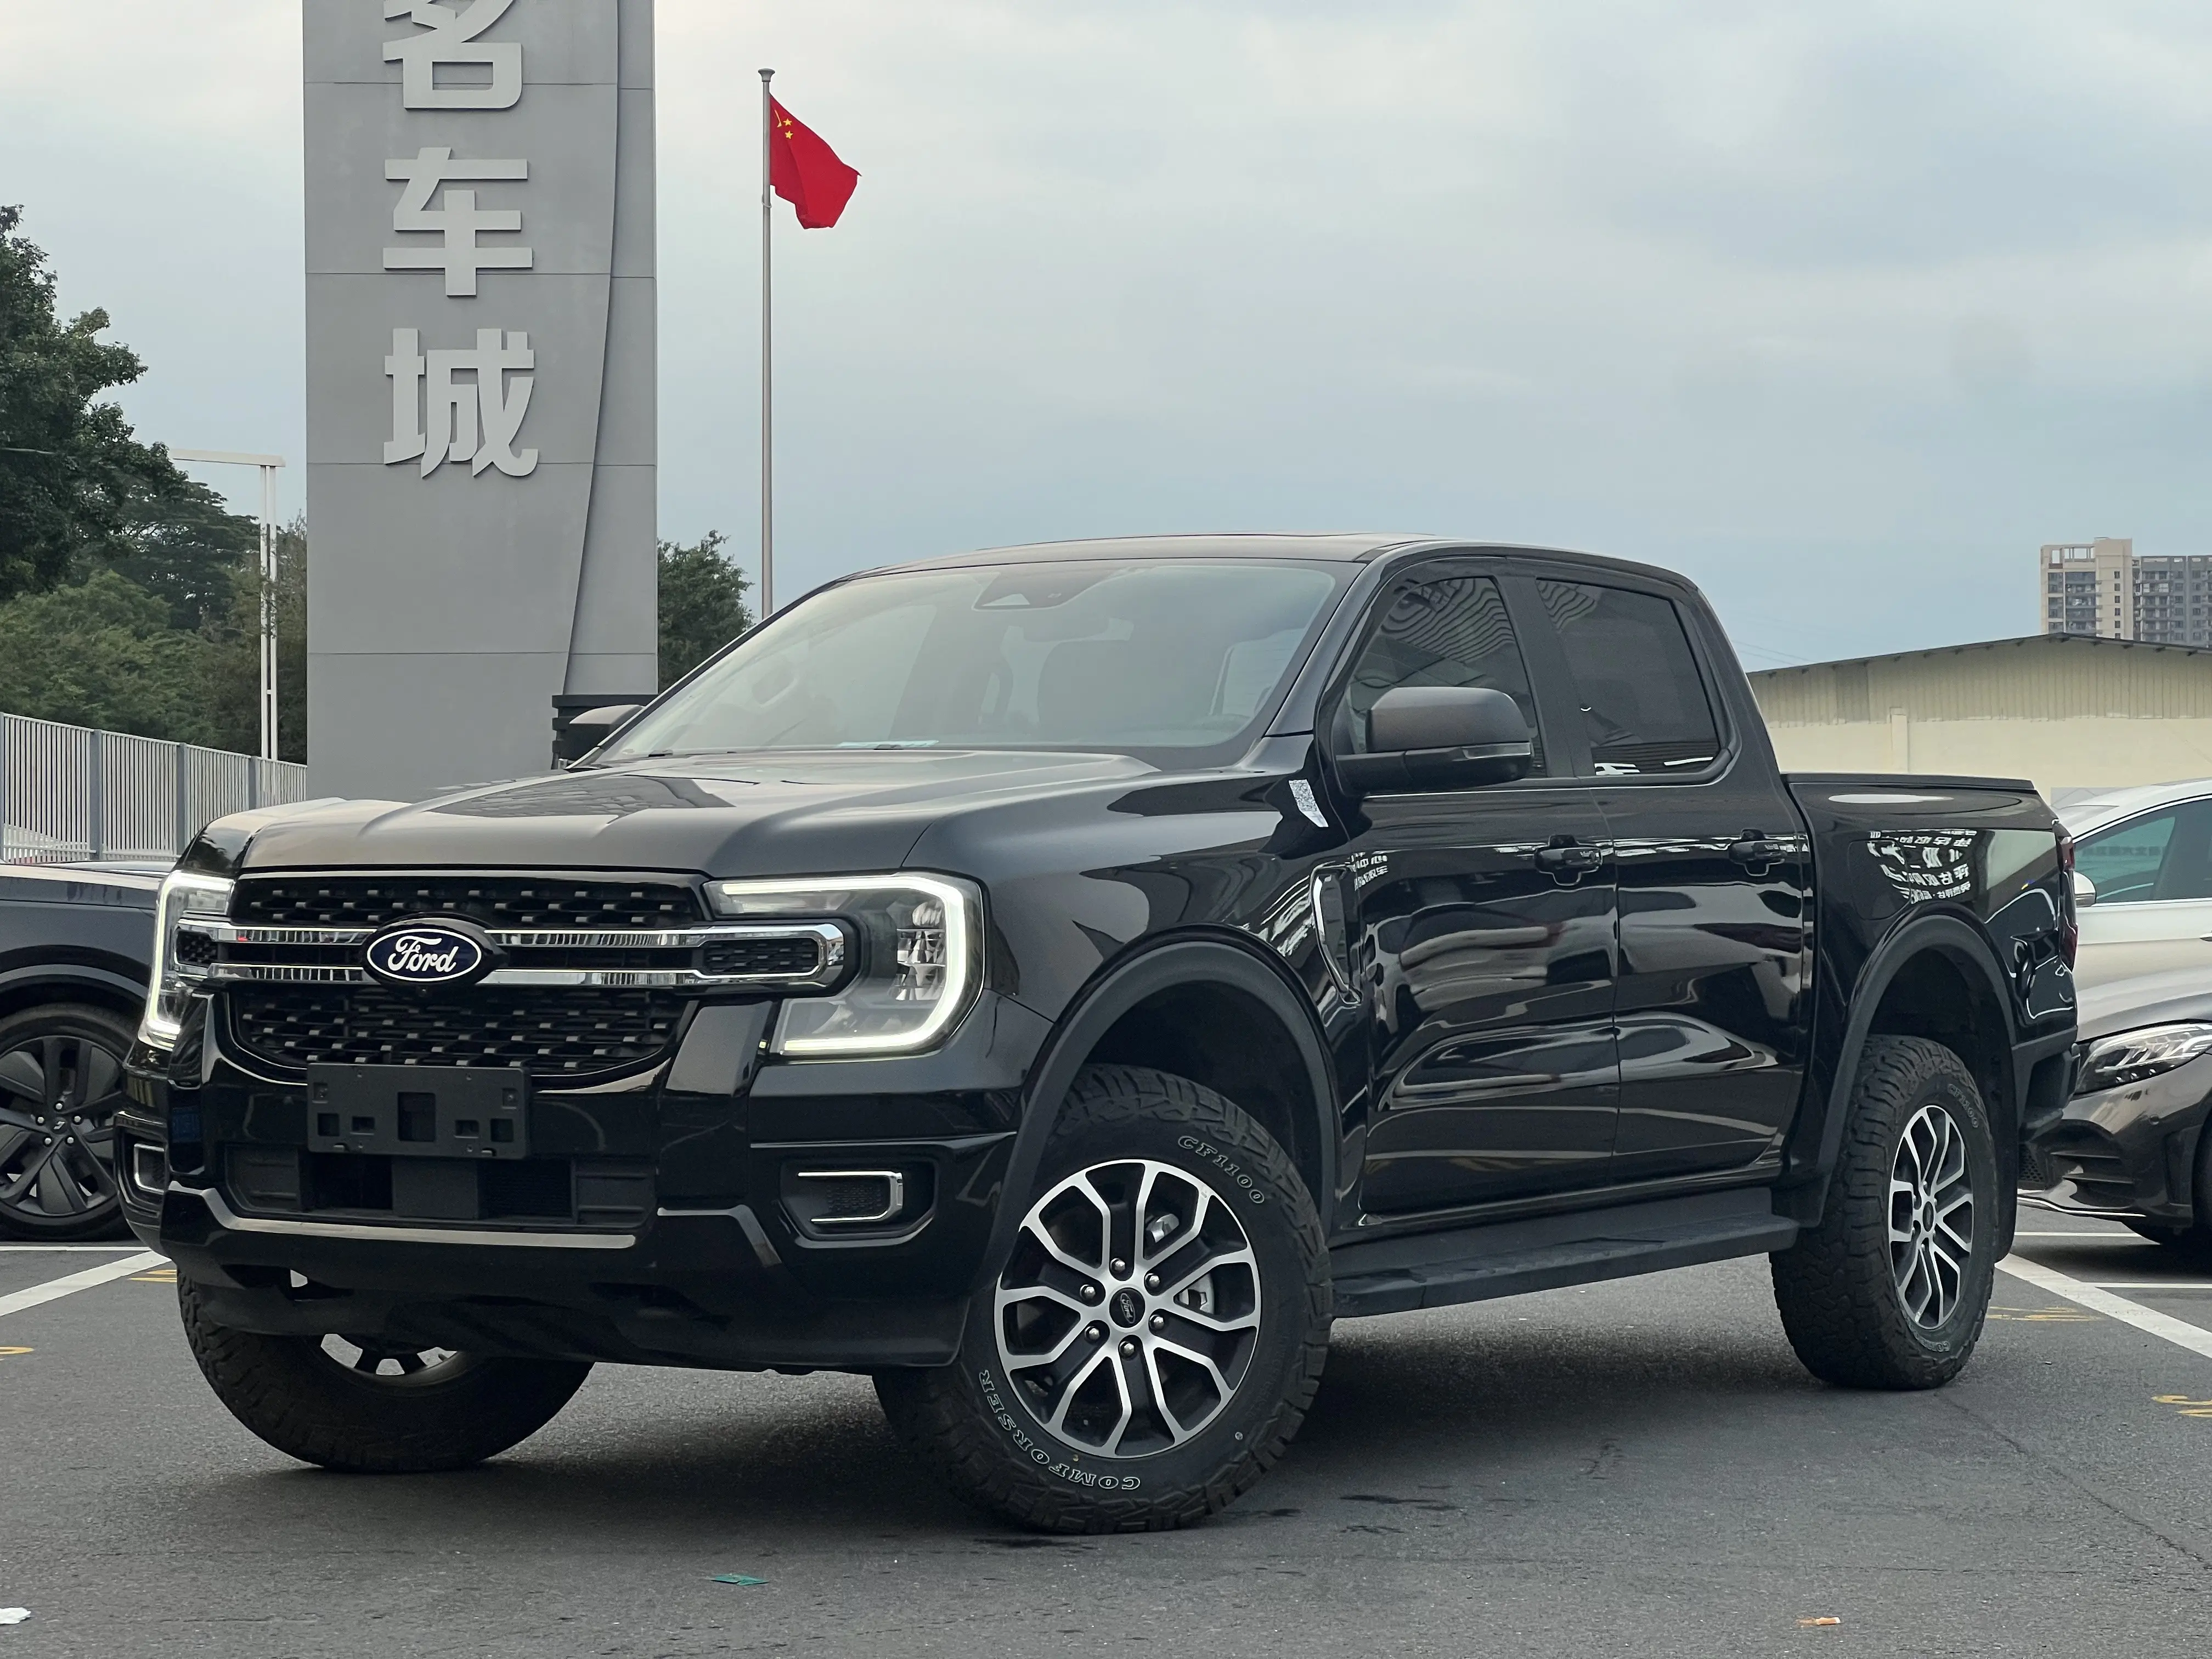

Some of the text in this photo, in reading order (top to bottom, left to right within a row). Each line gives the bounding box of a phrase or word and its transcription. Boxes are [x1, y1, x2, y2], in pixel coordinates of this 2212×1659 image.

[383, 0, 539, 478] 名车城
[387, 935, 459, 973] Ford
[1177, 1135, 1265, 1204] CF1100
[979, 1369, 1141, 1491] COMFORSER
